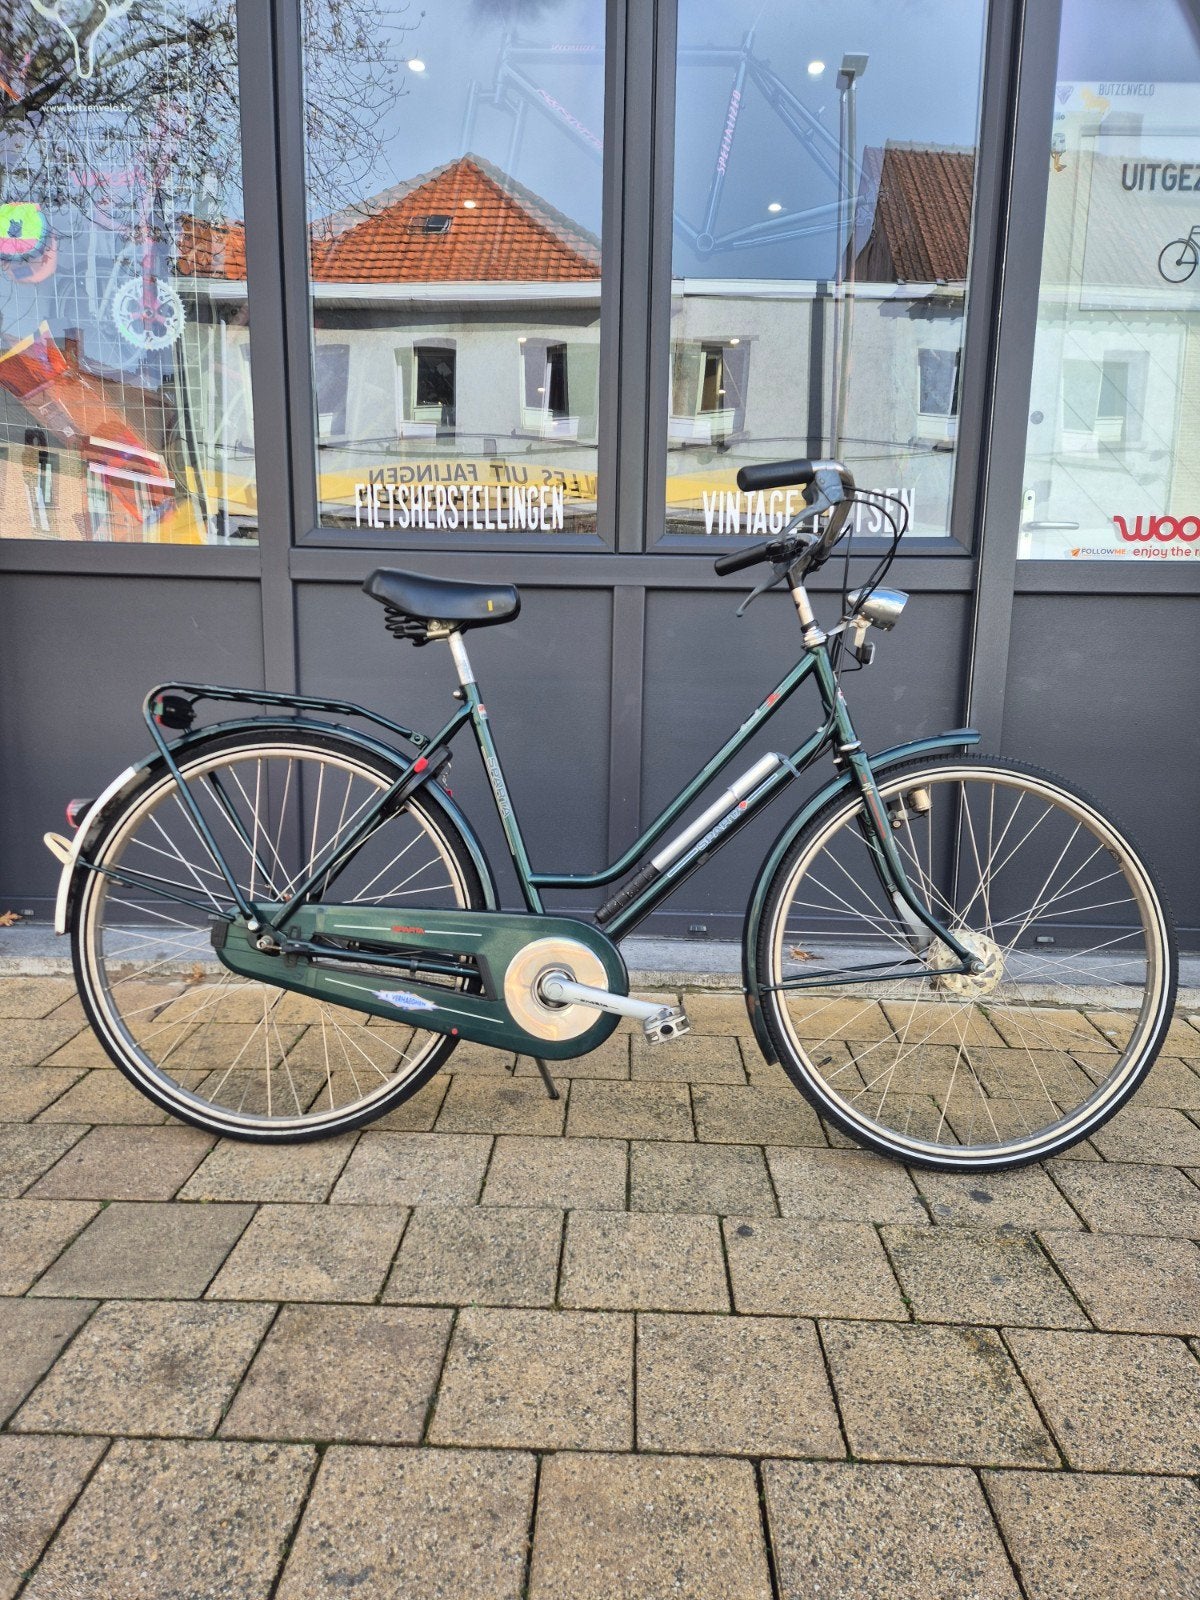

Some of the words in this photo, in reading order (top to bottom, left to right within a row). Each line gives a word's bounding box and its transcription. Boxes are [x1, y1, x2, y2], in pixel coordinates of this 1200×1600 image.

[1098, 83, 1155, 97] BUTZENVELO
[354, 483, 564, 529] FIETSHERSTELLINGEN
[702, 489, 799, 534] VINTAGE
[1133, 545, 1168, 558] enjoy
[1171, 546, 1192, 556] the
[486, 756, 512, 818] SPARTA
[697, 806, 742, 851] SPARTA
